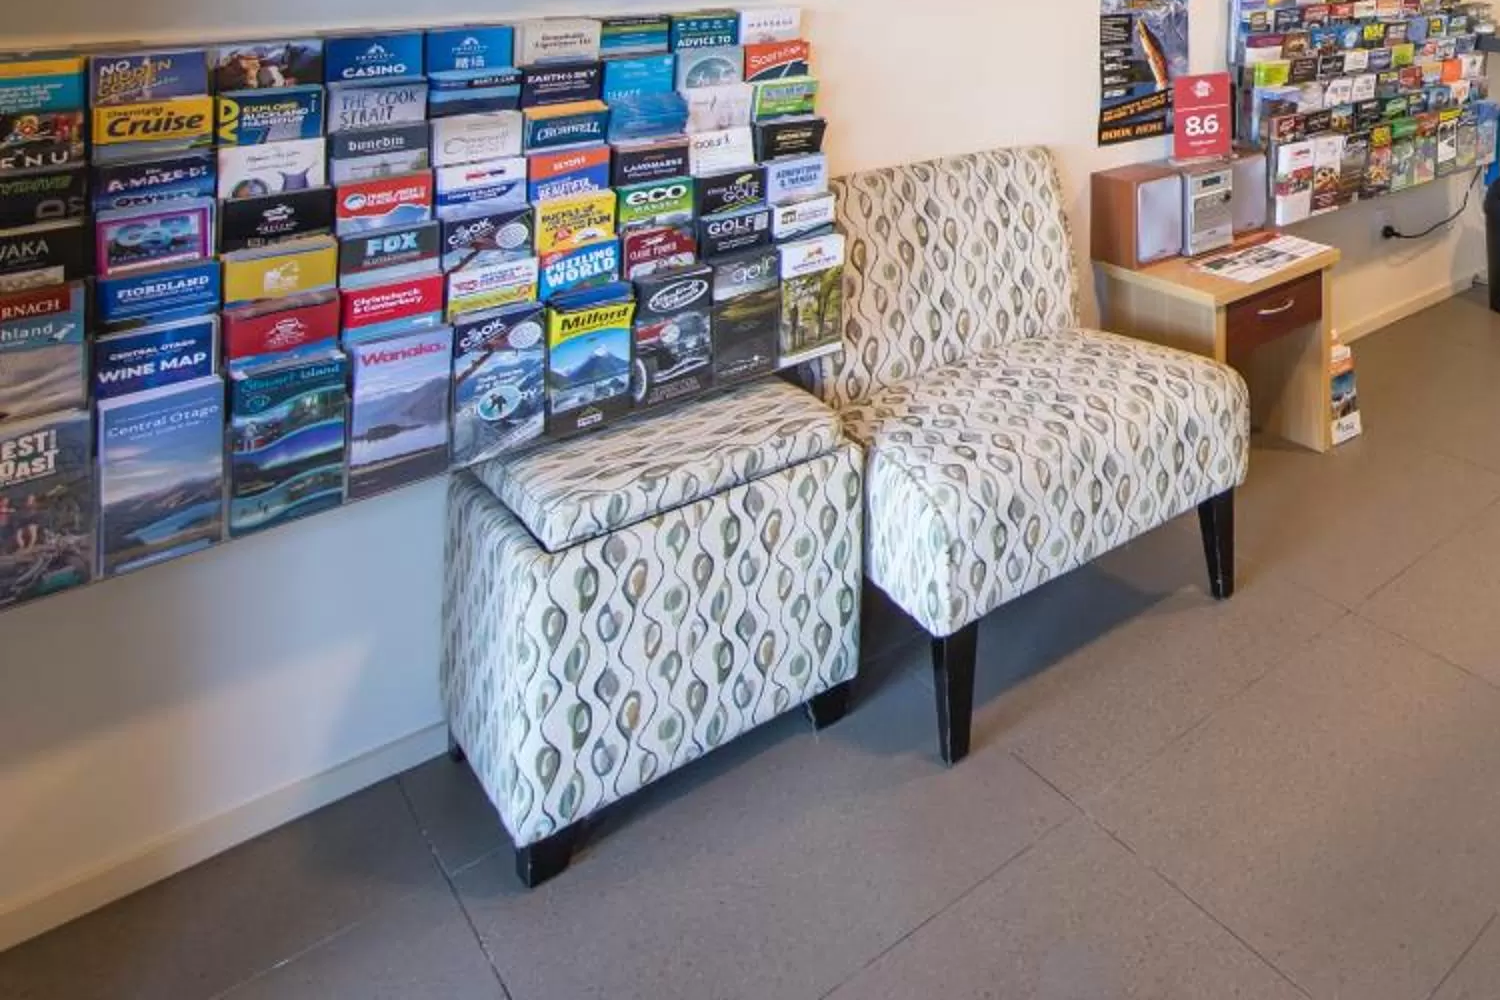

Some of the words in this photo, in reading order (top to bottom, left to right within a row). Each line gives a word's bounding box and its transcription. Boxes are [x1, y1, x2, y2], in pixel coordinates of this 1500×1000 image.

[341, 63, 408, 79] CASINO
[106, 111, 204, 137] Cruise
[1184, 113, 1219, 137] 8.6
[348, 136, 405, 151] Dunedin
[707, 216, 753, 236] GOLF
[367, 231, 419, 257] FOX
[544, 246, 615, 274] PUZZLING
[545, 257, 616, 288] WORLD
[116, 275, 209, 300] FIORDLAND
[353, 287, 421, 307] Christchurch
[560, 306, 629, 332] Milford
[108, 346, 158, 362] CENTRAL
[361, 344, 447, 367] Wanaka
[97, 363, 156, 384] WINE
[160, 352, 208, 372] MAP
[108, 411, 167, 438] Central
[169, 404, 219, 424] Otago
